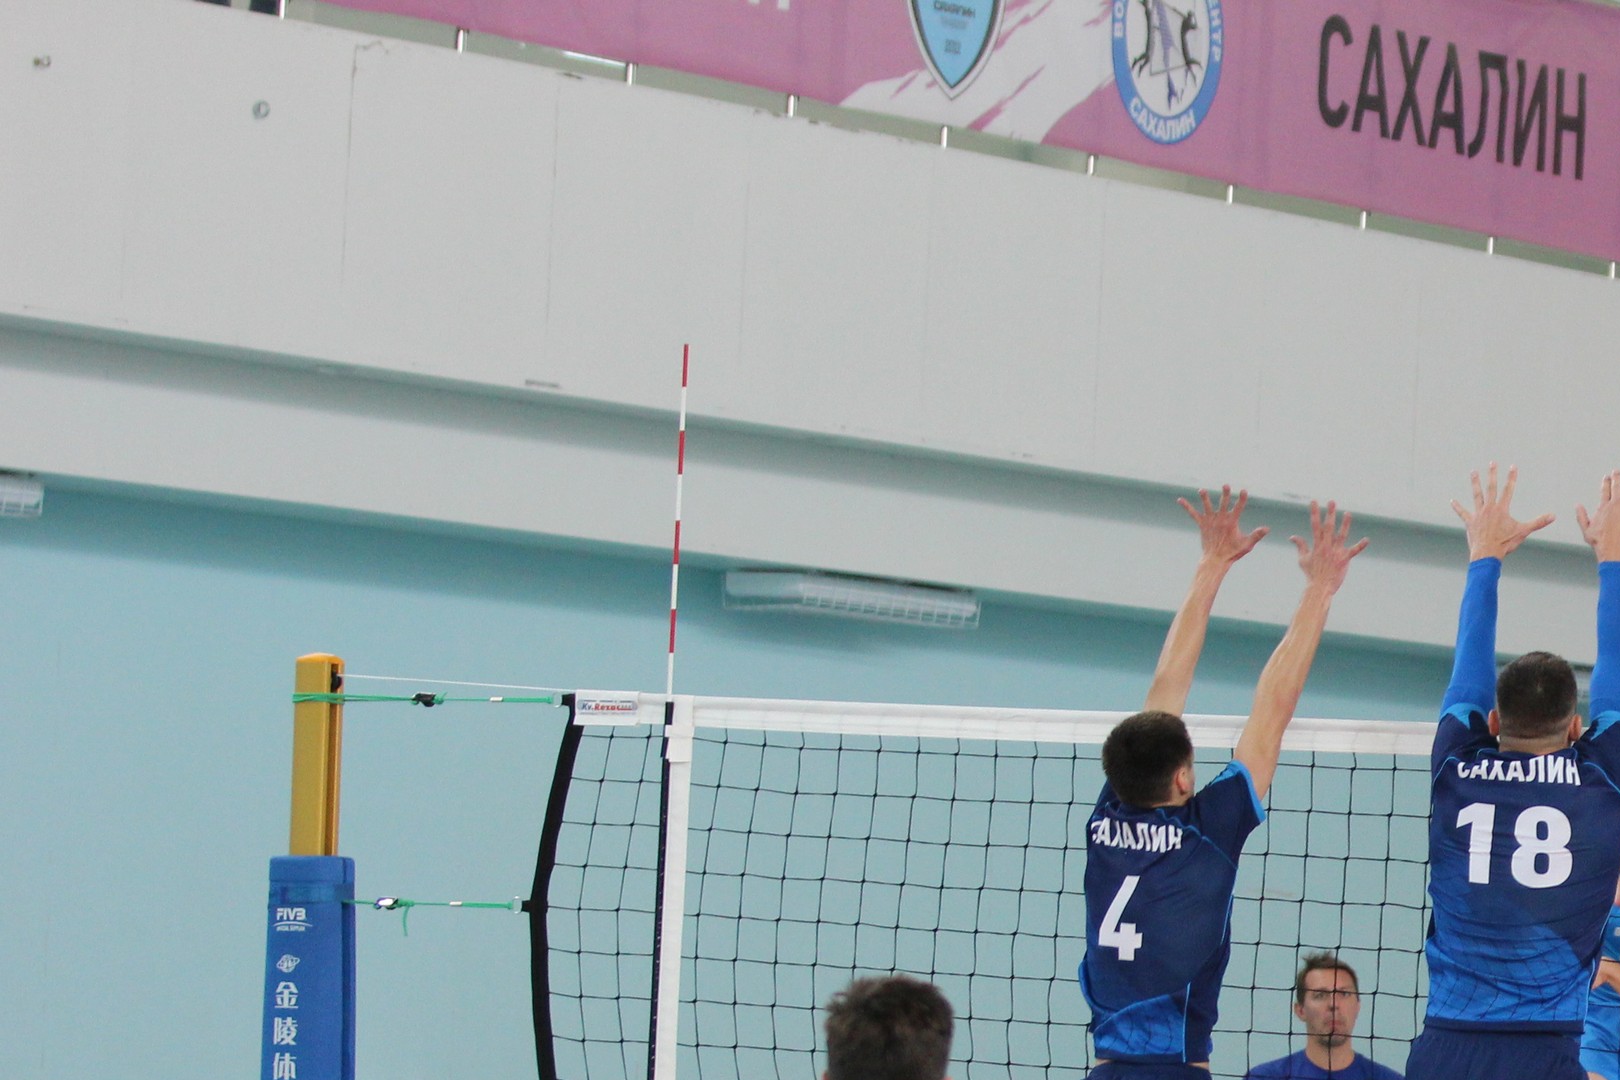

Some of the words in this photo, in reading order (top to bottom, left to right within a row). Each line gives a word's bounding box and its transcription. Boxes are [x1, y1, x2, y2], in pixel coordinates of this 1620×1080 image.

[1130, 97, 1197, 140] САХАЛИН
[1317, 13, 1587, 181] САХАЛИН
[1457, 755, 1582, 786] САХАЛИН
[1456, 802, 1573, 889] 18
[276, 907, 306, 921] FIVB
[1098, 875, 1143, 961] 4
